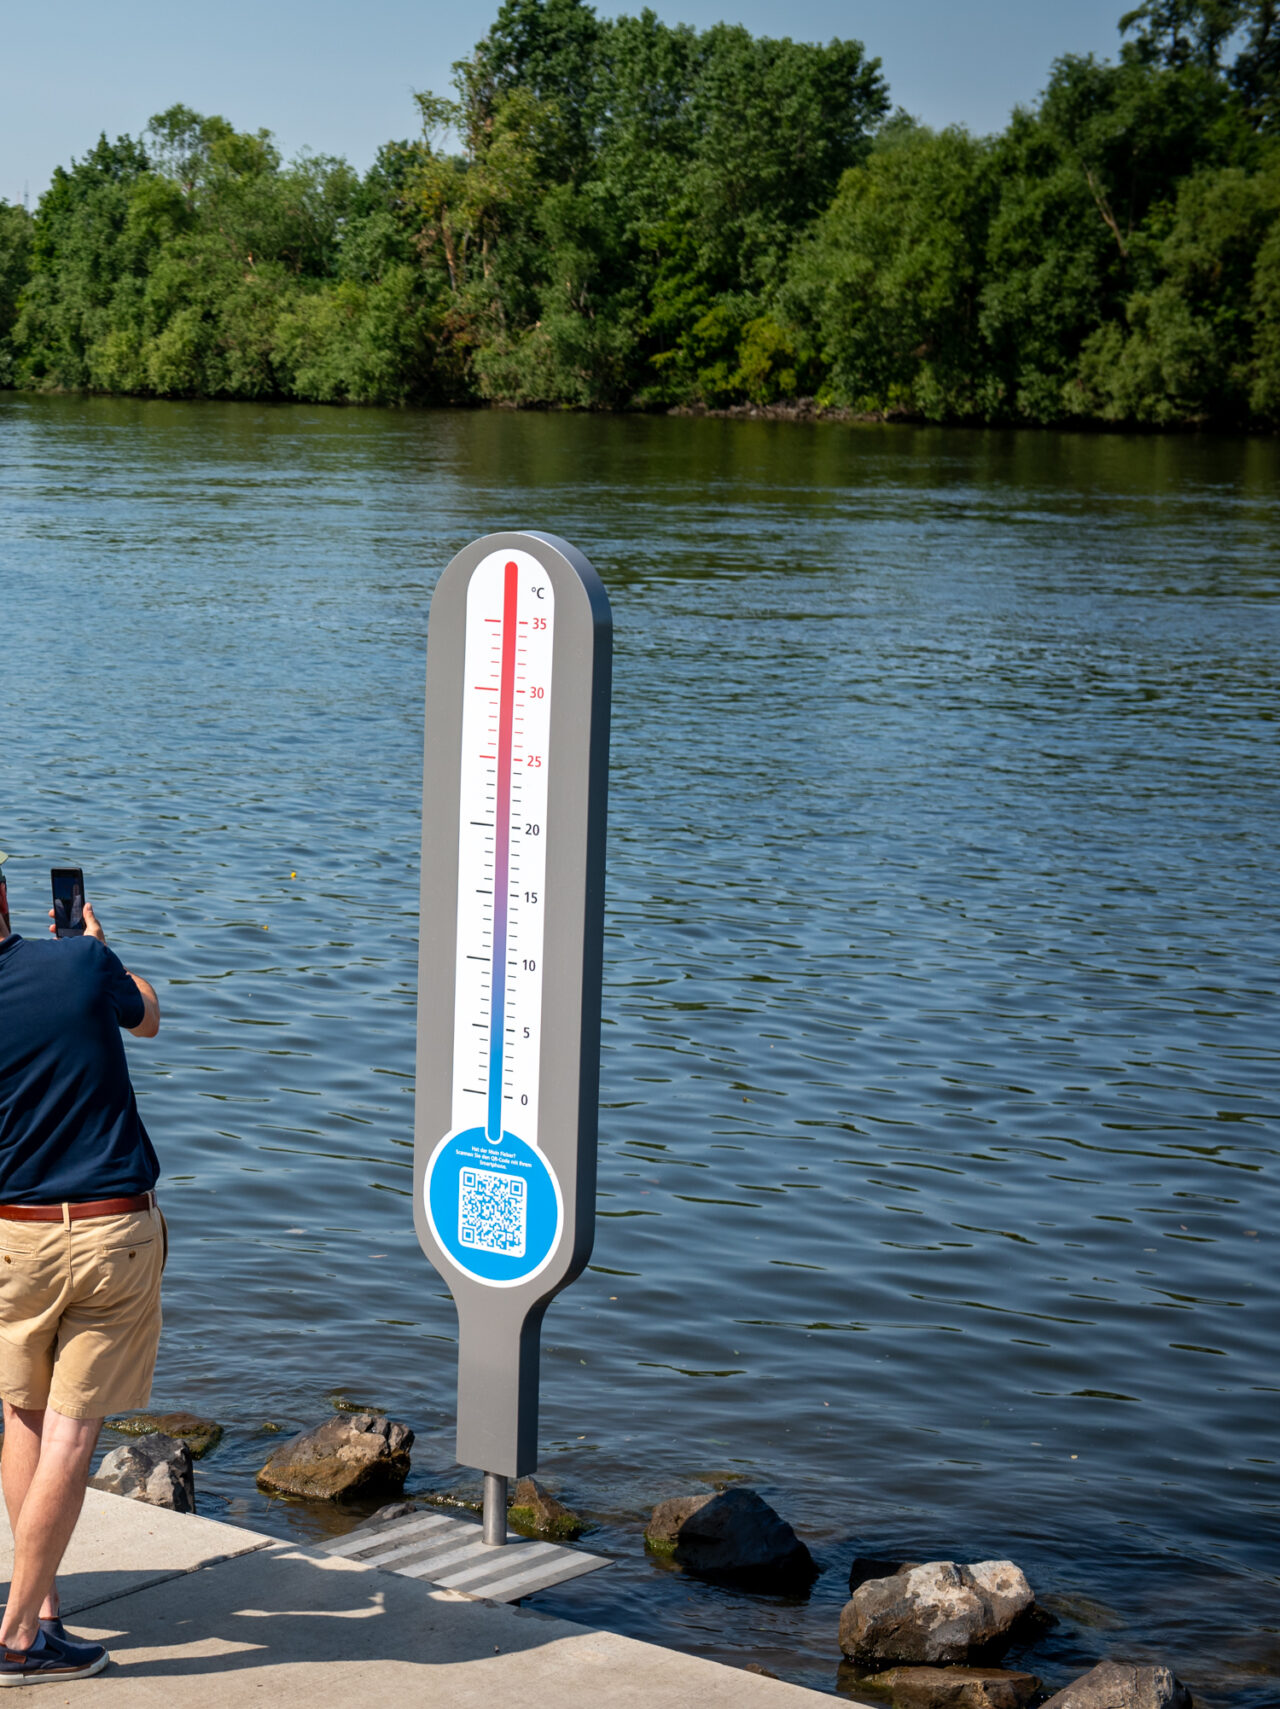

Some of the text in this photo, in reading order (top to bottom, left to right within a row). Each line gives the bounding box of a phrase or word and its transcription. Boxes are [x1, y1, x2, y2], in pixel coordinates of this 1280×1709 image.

[531, 587, 545, 600] °C
[532, 617, 547, 631] 35
[529, 686, 545, 700] 30
[527, 754, 542, 768] 25
[525, 823, 540, 836] 20
[524, 891, 538, 904] 15
[522, 959, 536, 972] 10
[523, 1026, 530, 1039] 5
[520, 1093, 528, 1106] 0
[455, 1149, 473, 1157] Scannen
[490, 1156, 510, 1164] QR-Code
